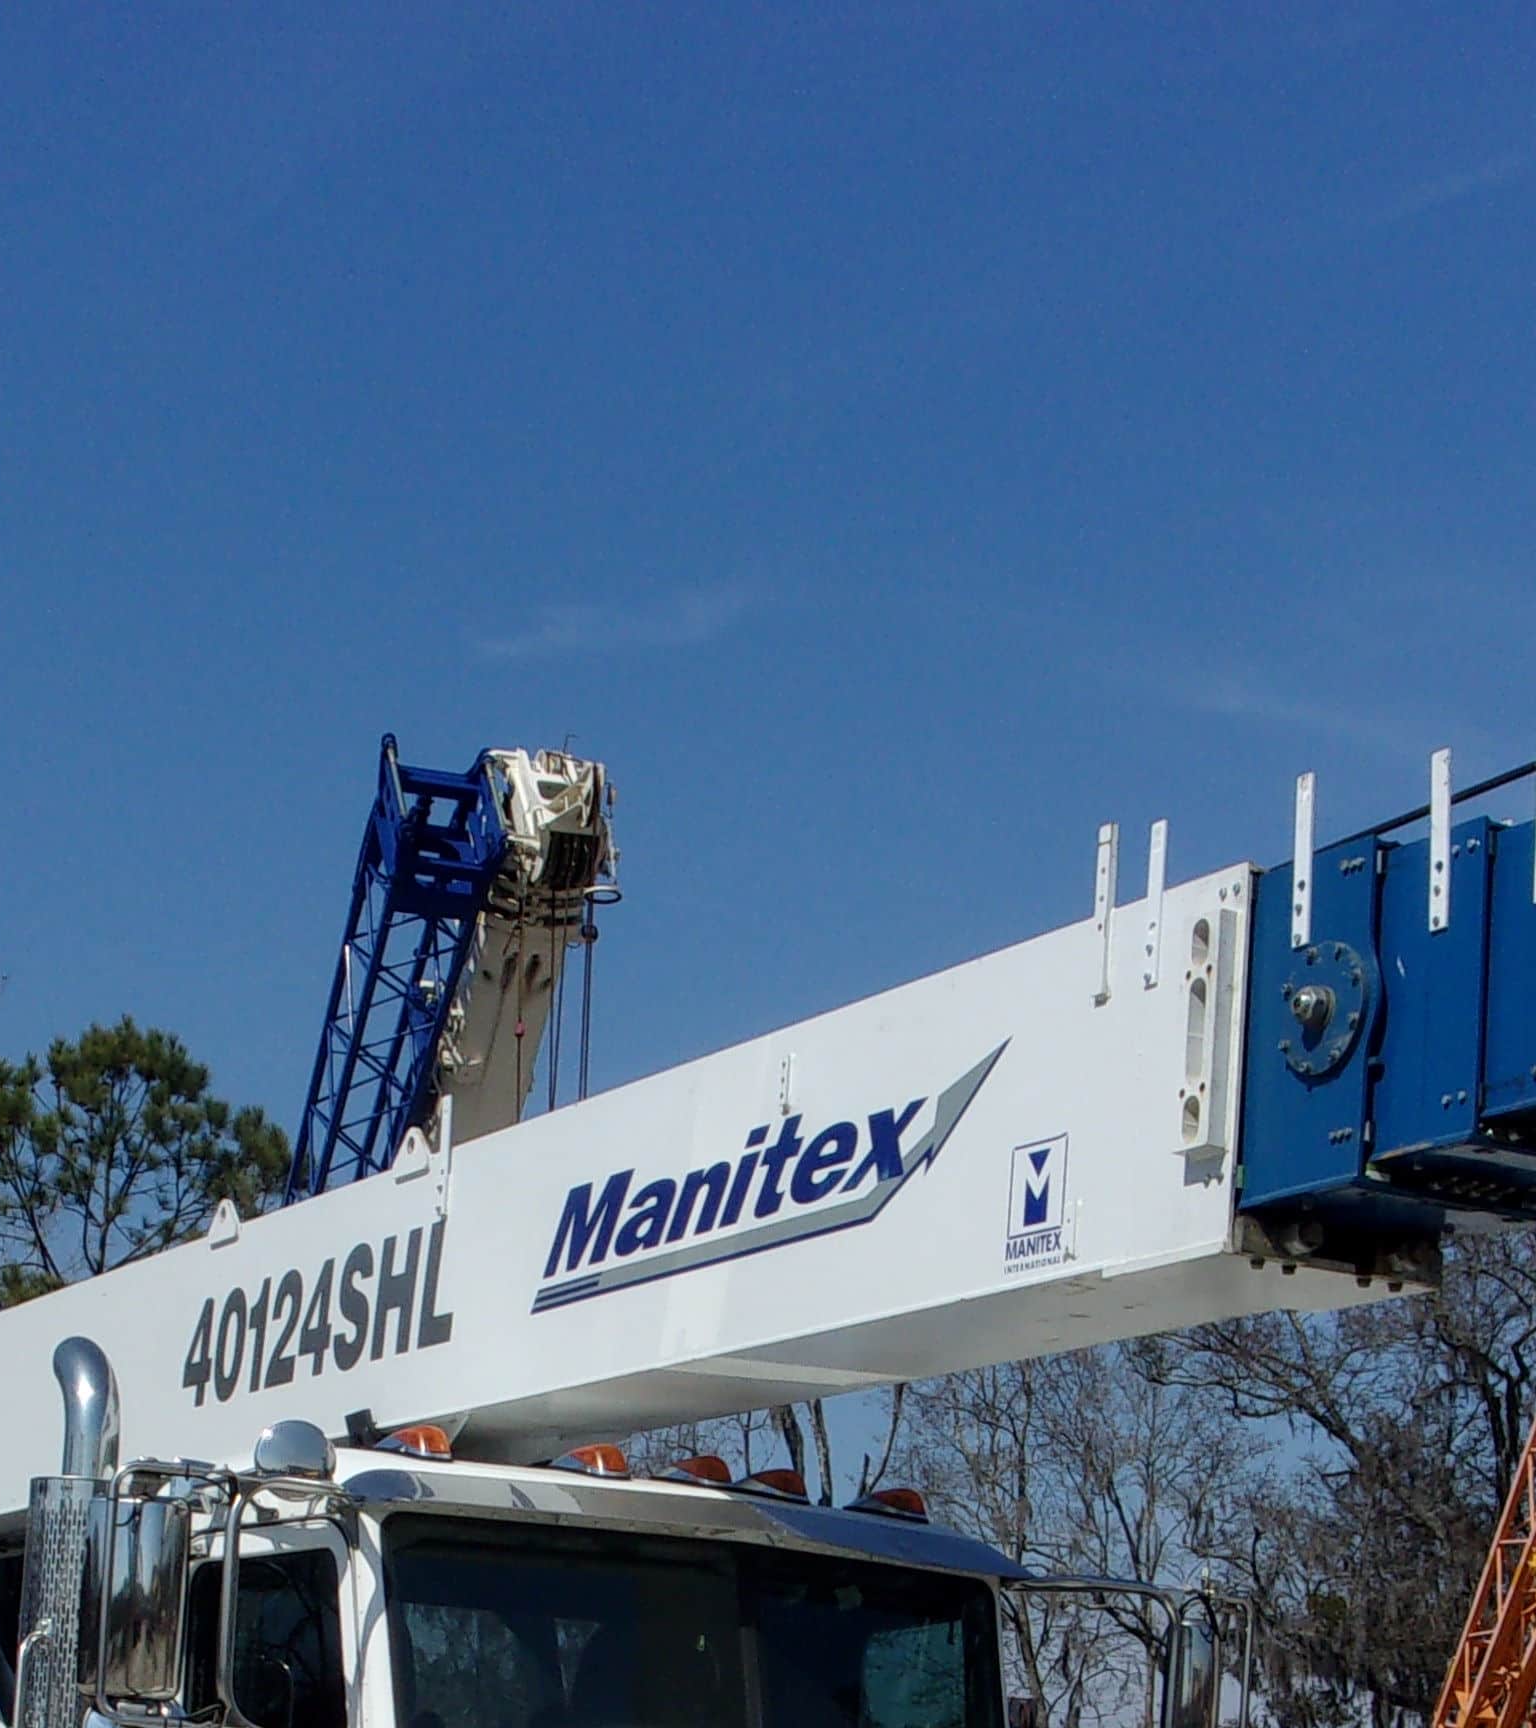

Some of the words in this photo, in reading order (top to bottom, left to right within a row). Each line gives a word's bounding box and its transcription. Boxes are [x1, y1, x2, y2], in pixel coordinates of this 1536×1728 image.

[542, 1096, 927, 1279] Manitex
[1004, 1231, 1062, 1261] MANITEX
[1004, 1256, 1062, 1275] INTERNATIONAL
[183, 1220, 453, 1408] 40124SHL
